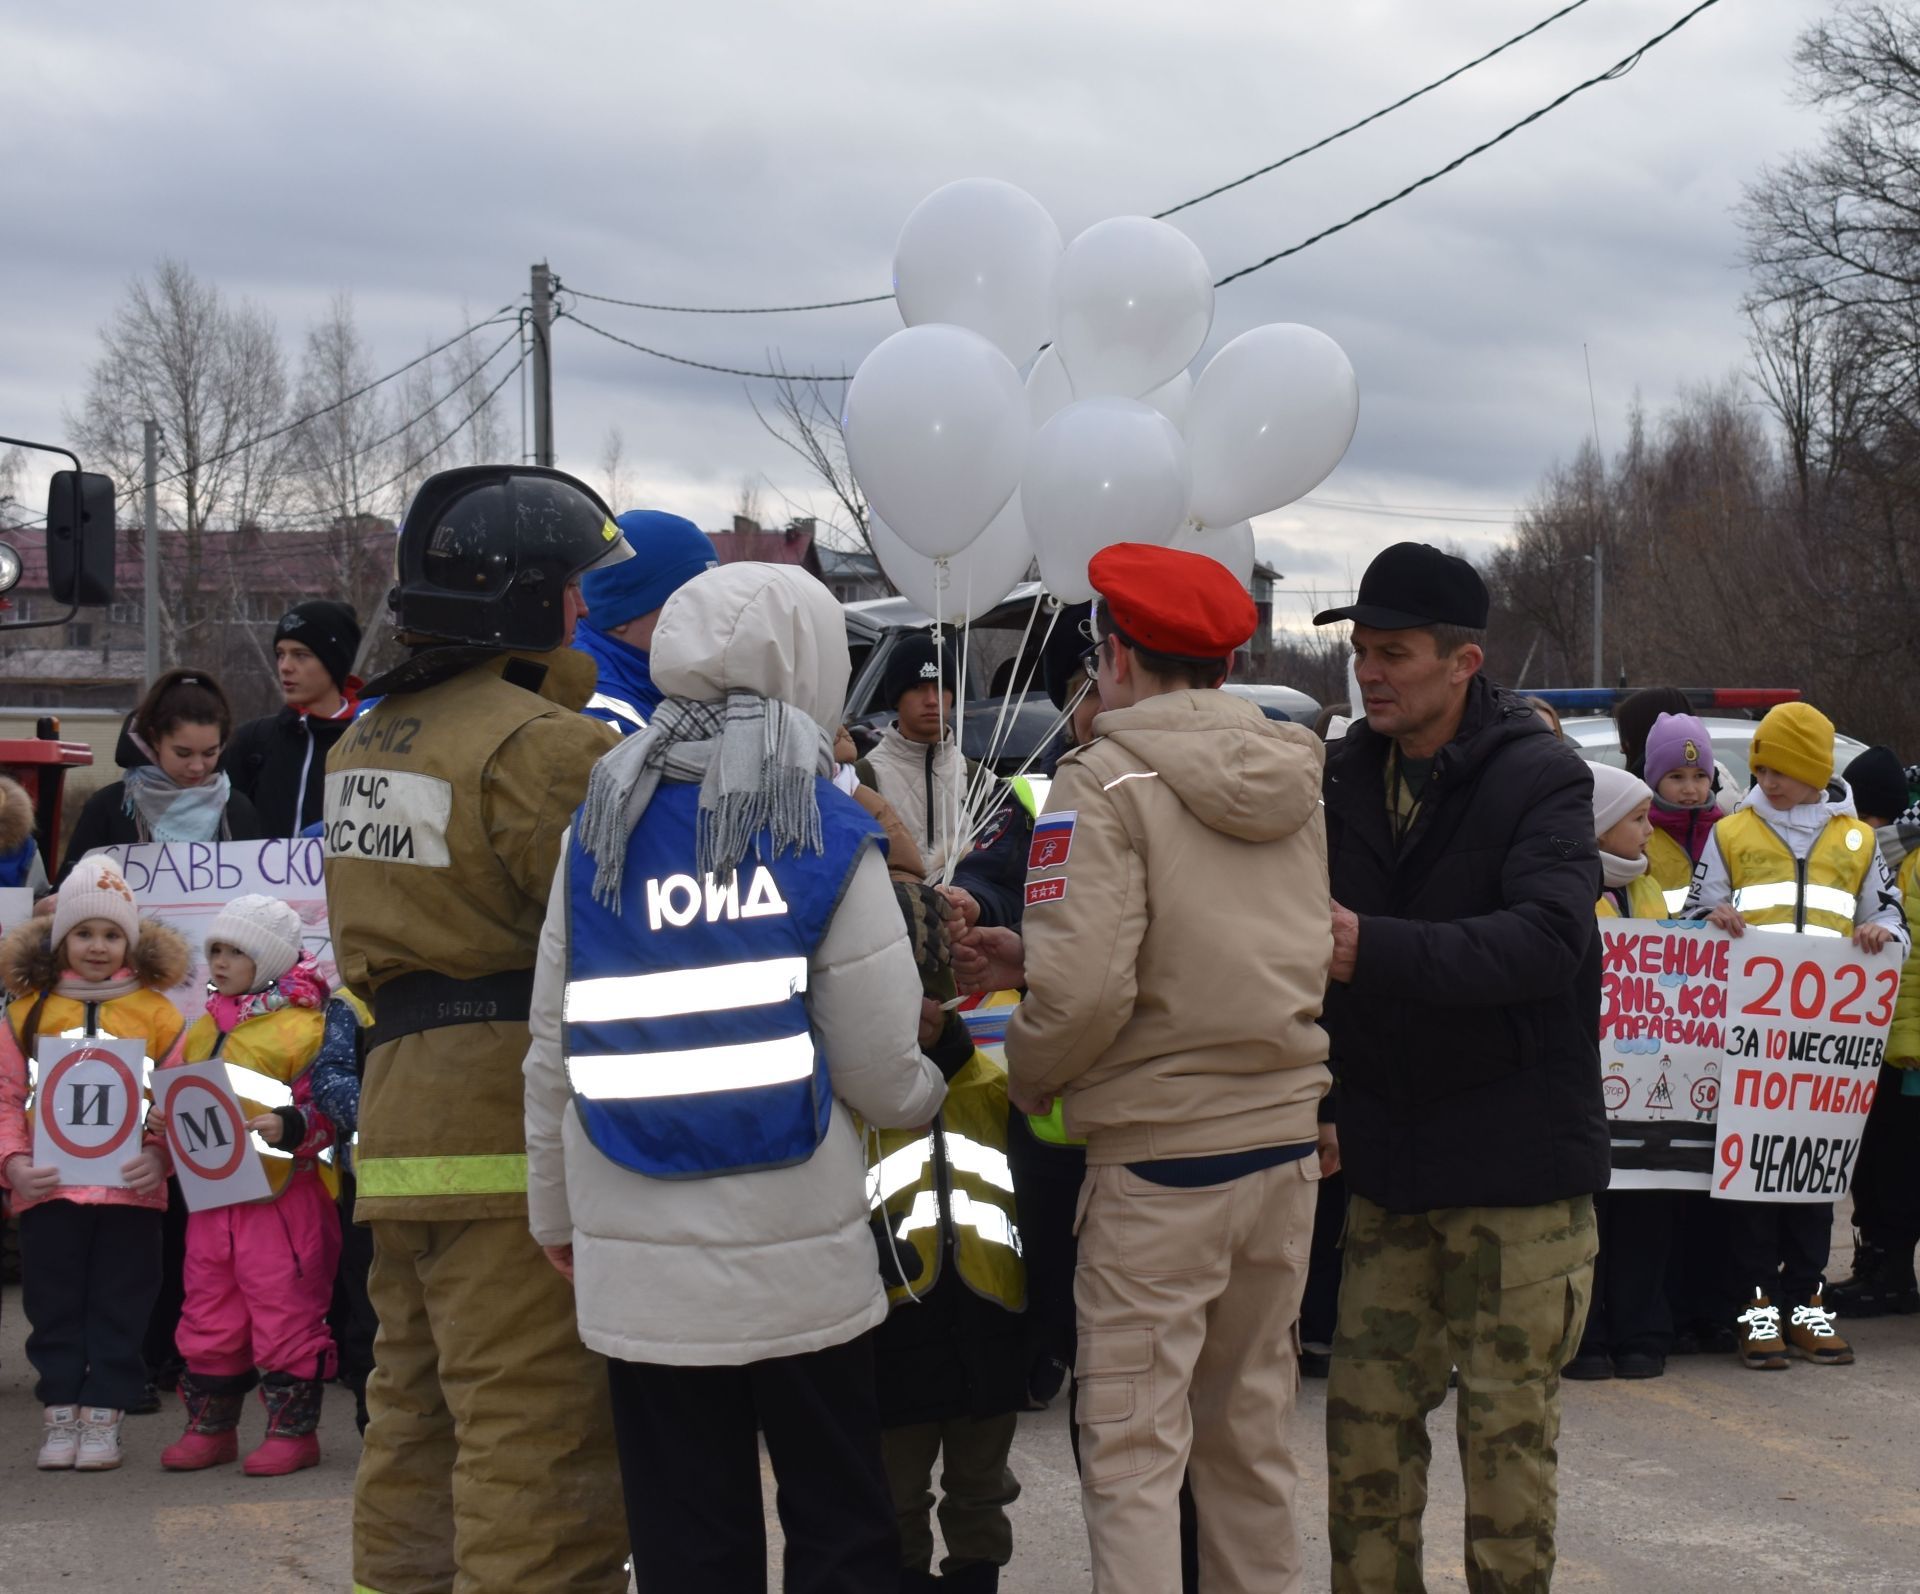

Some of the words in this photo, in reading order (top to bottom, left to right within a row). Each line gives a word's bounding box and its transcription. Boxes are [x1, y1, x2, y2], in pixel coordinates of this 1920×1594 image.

[339, 775, 390, 810] МЧС
[257, 837, 324, 887] СКО
[646, 865, 788, 931] ЮИД
[1601, 931, 1730, 982] ЖЕНИЕ
[1678, 983, 1728, 1019] КО
[1741, 955, 1899, 1027] 2023
[1614, 1014, 1726, 1049] ПРАВИЛ
[1725, 1025, 1759, 1058] ЗА
[1765, 1028, 1788, 1060] 10
[1788, 1031, 1884, 1070] МЕСЯЦЕВ
[66, 1083, 121, 1126] И
[1604, 1085, 1624, 1097] STOP
[1695, 1085, 1717, 1104] 50
[1733, 1068, 1877, 1115] ПОГИБЛО
[175, 1105, 232, 1153] М
[1718, 1133, 1744, 1190] 9
[1750, 1133, 1859, 1194] ЧЕЛОВЕК
